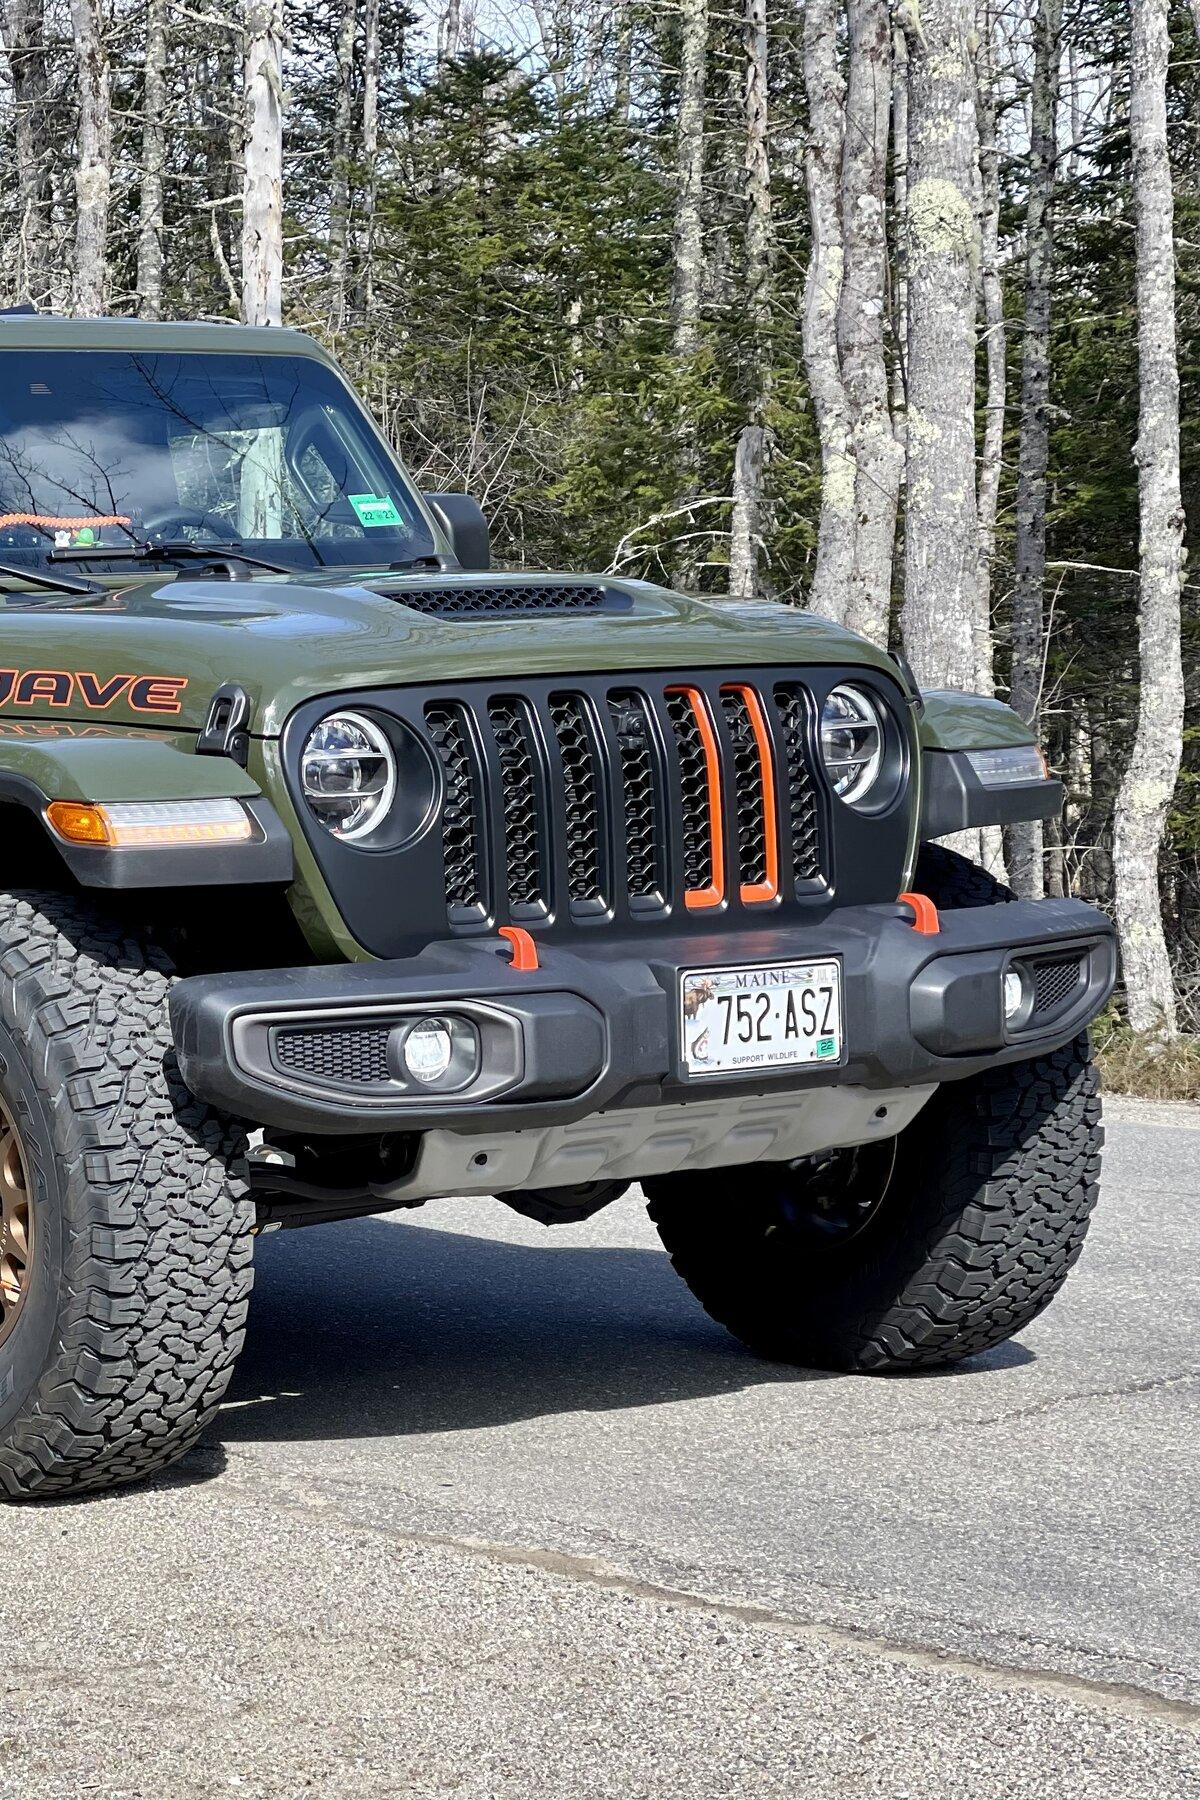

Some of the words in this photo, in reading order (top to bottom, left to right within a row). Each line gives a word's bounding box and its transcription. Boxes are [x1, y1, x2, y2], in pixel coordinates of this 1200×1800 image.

[362, 511, 374, 520] 22
[382, 510, 395, 519] 23
[735, 970, 791, 988] MAINE
[820, 1041, 833, 1050] 22
[732, 1055, 765, 1065] SUPPORT
[767, 1050, 798, 1061] WILDLIFE
